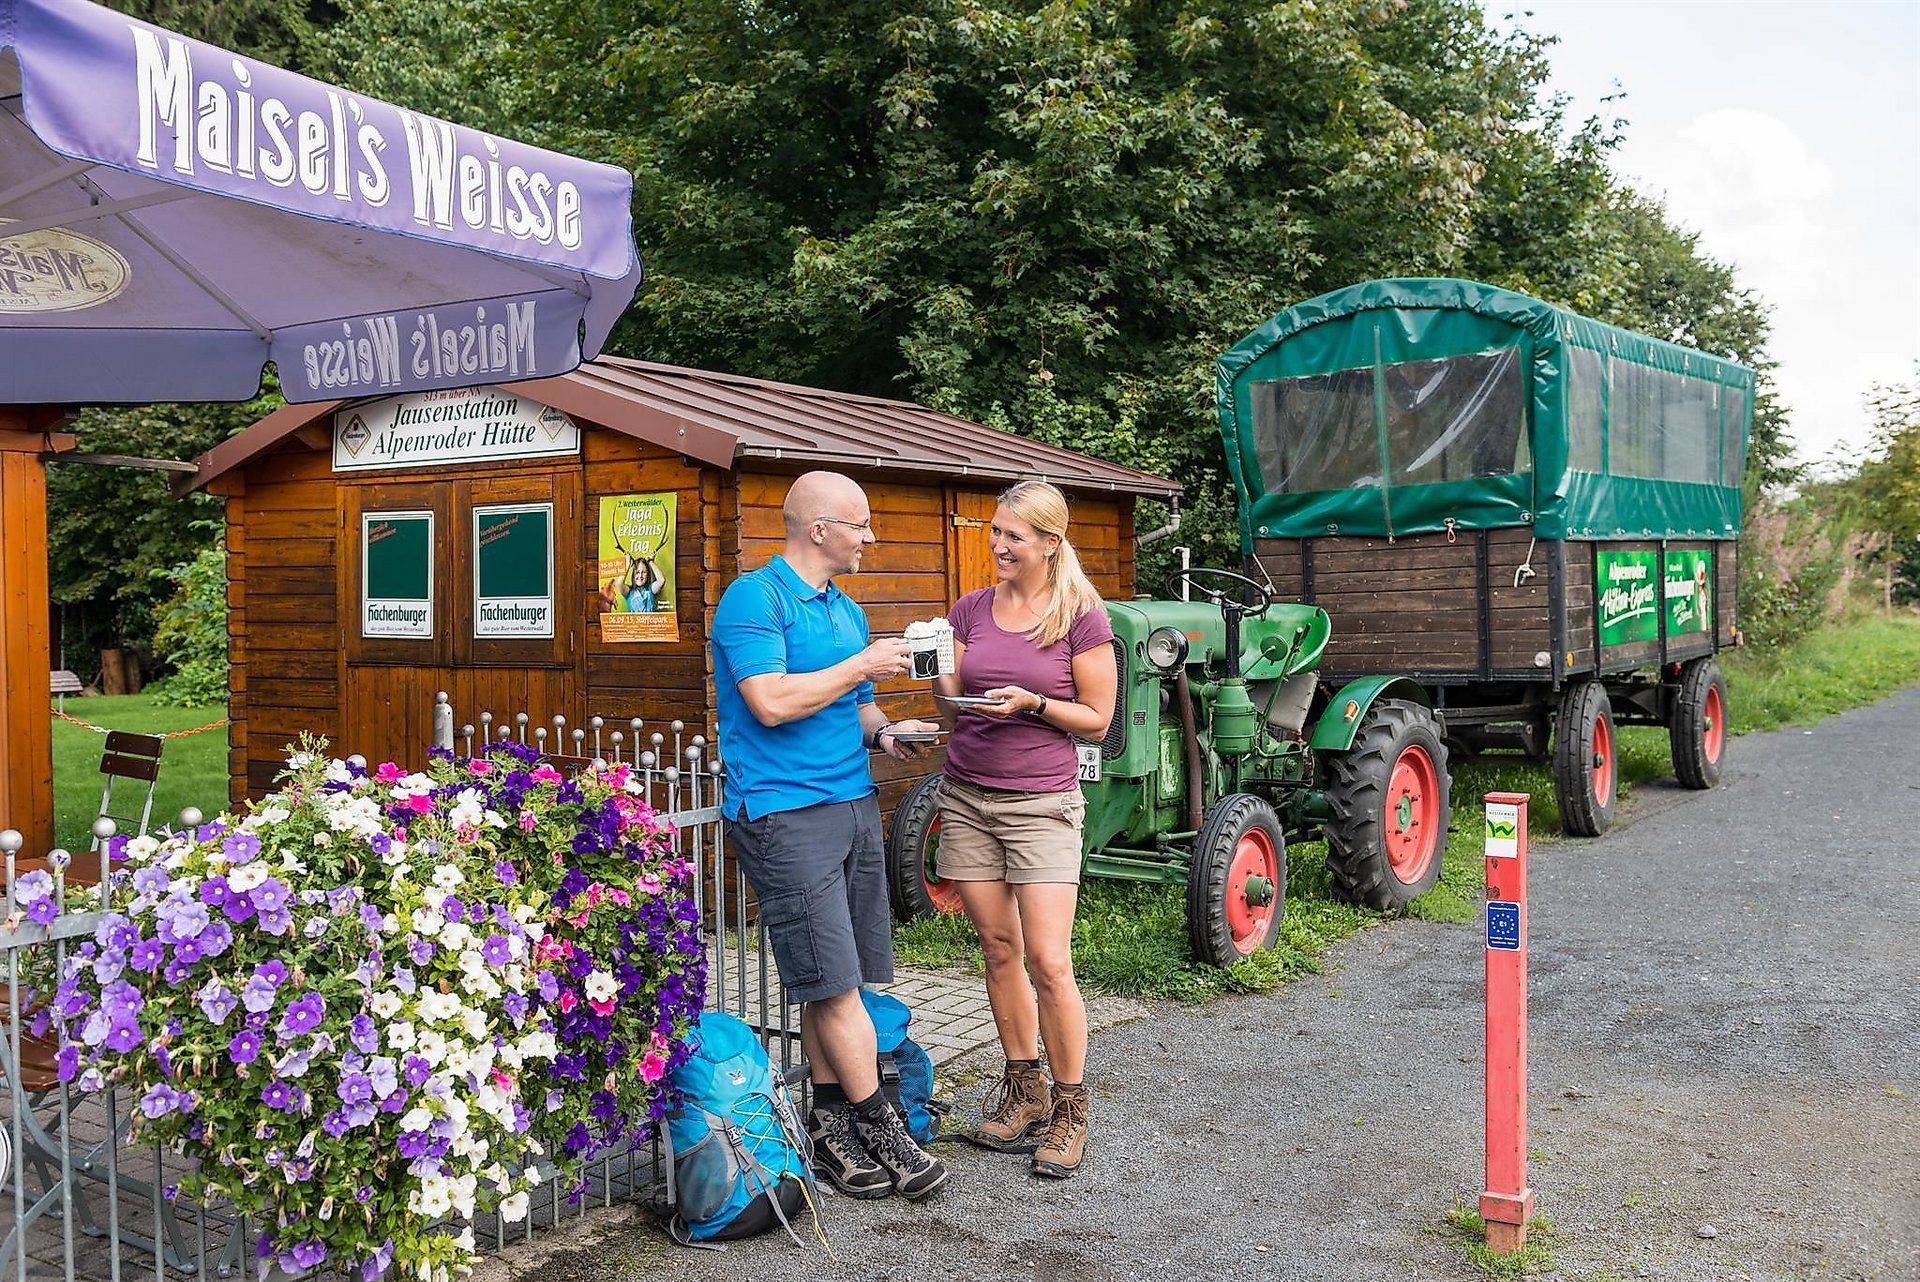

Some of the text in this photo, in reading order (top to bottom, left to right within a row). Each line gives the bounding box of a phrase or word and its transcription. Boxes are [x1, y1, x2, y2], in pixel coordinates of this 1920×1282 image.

[128, 25, 583, 251] Maisel's Weisse
[468, 387, 481, 397] NN
[390, 394, 518, 429] Jausenstation
[372, 421, 536, 459] Alpenroder Hütte
[624, 507, 652, 523] Jagd
[617, 521, 662, 537] Erlebnis
[629, 538, 650, 554] Tag
[1080, 764, 1096, 779] 78
